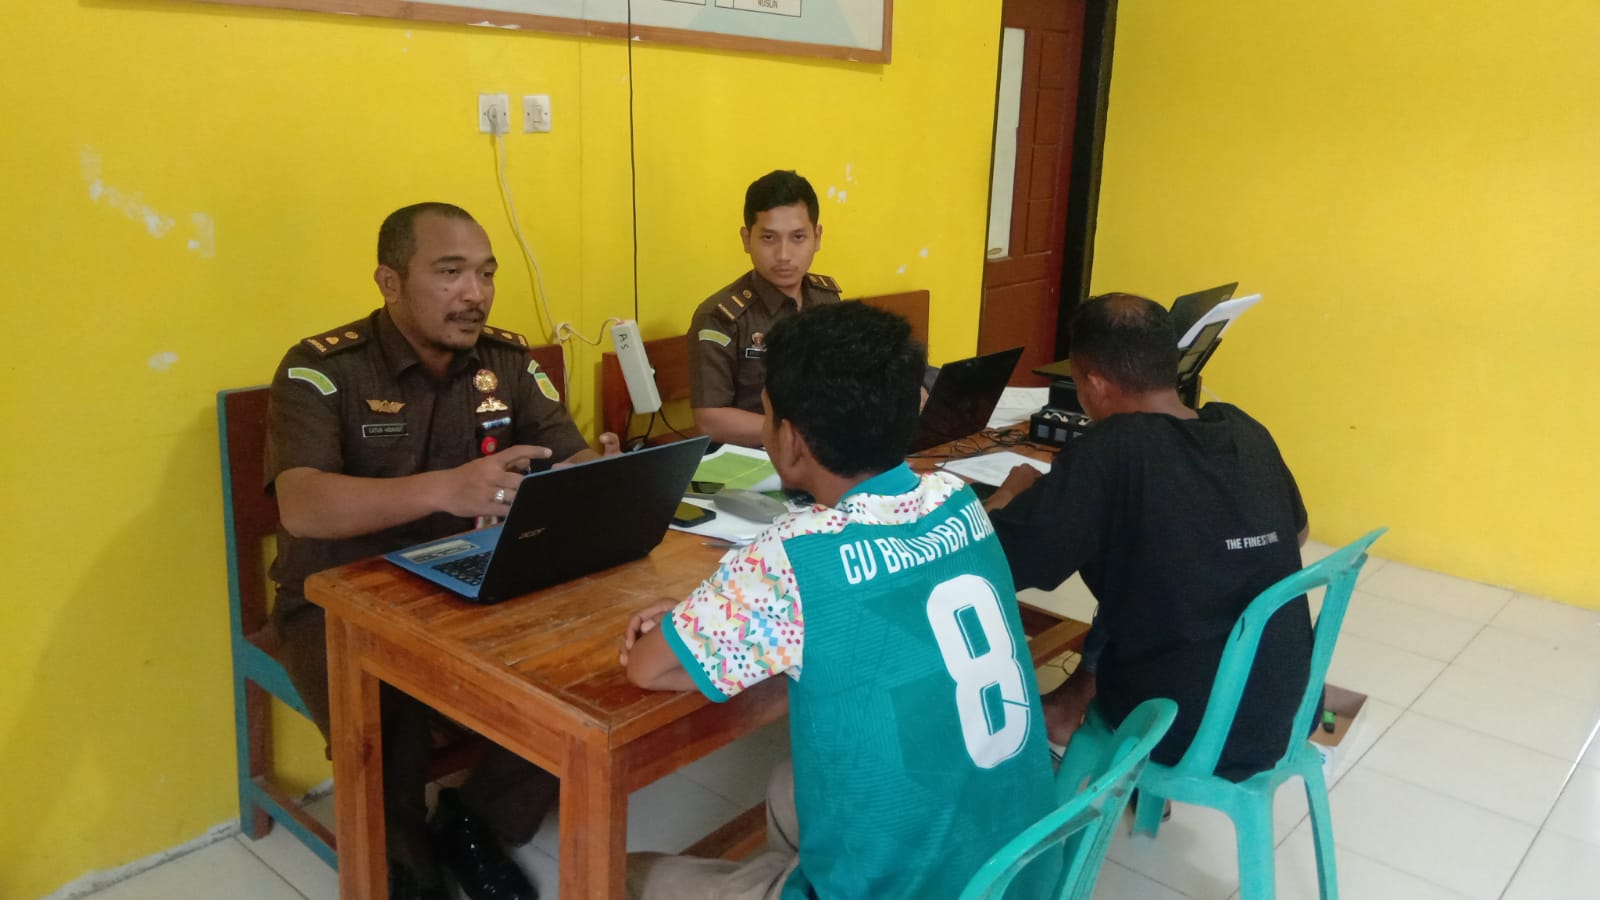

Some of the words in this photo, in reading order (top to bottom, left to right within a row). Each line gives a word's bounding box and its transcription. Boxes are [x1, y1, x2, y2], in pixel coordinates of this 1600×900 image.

[874, 517, 969, 574] BALUMBA
[1225, 537, 1243, 550] THE
[926, 573, 1031, 769] 8
